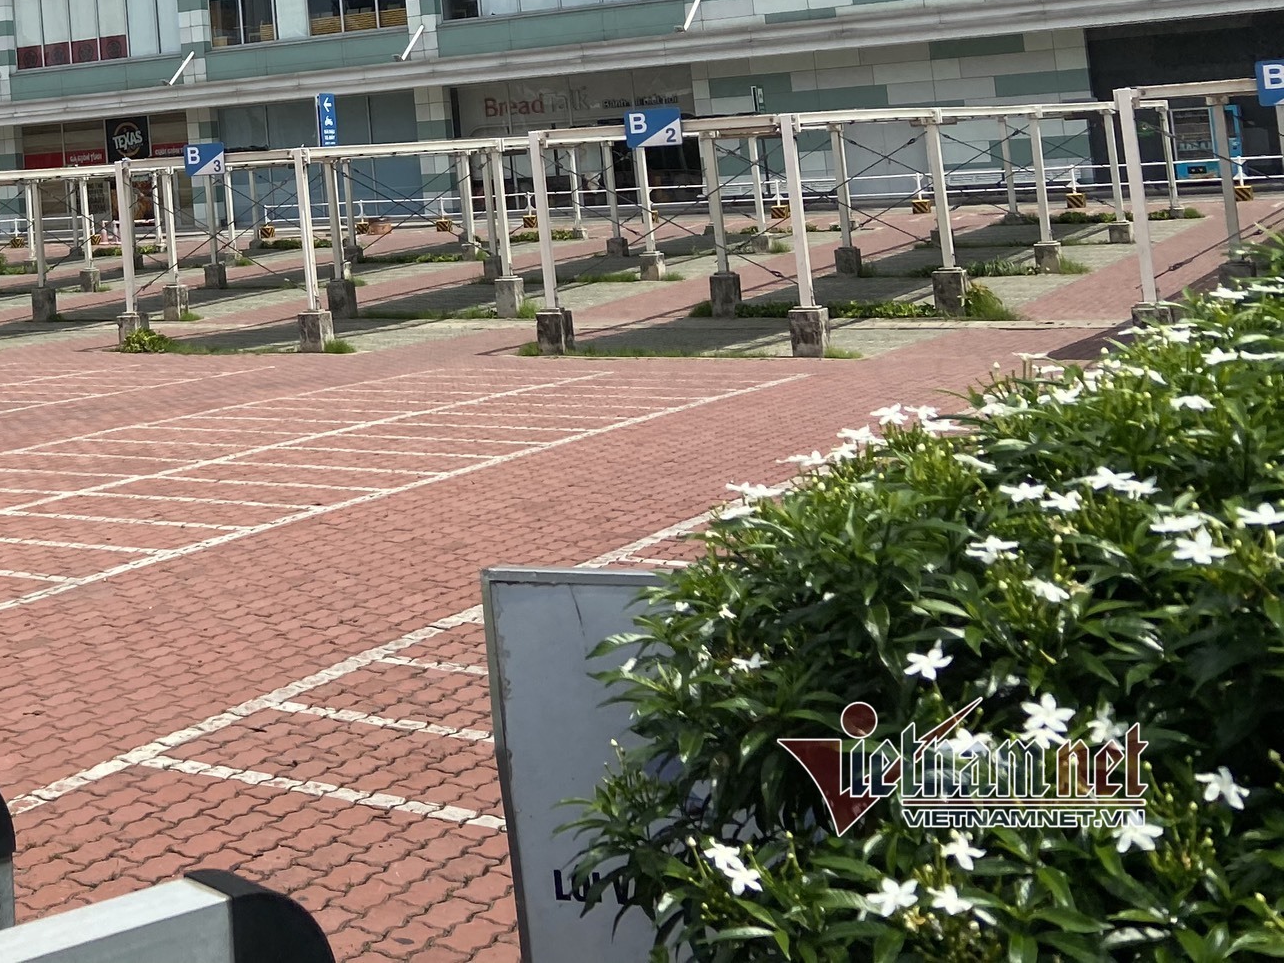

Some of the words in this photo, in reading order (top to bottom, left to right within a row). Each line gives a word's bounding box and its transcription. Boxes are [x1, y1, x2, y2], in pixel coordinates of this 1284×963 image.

[1262, 63, 1284, 90] B
[628, 112, 648, 135] B
[112, 130, 143, 151] TEXAS
[666, 127, 677, 143] 2
[186, 146, 201, 165] B
[213, 159, 221, 172] 3
